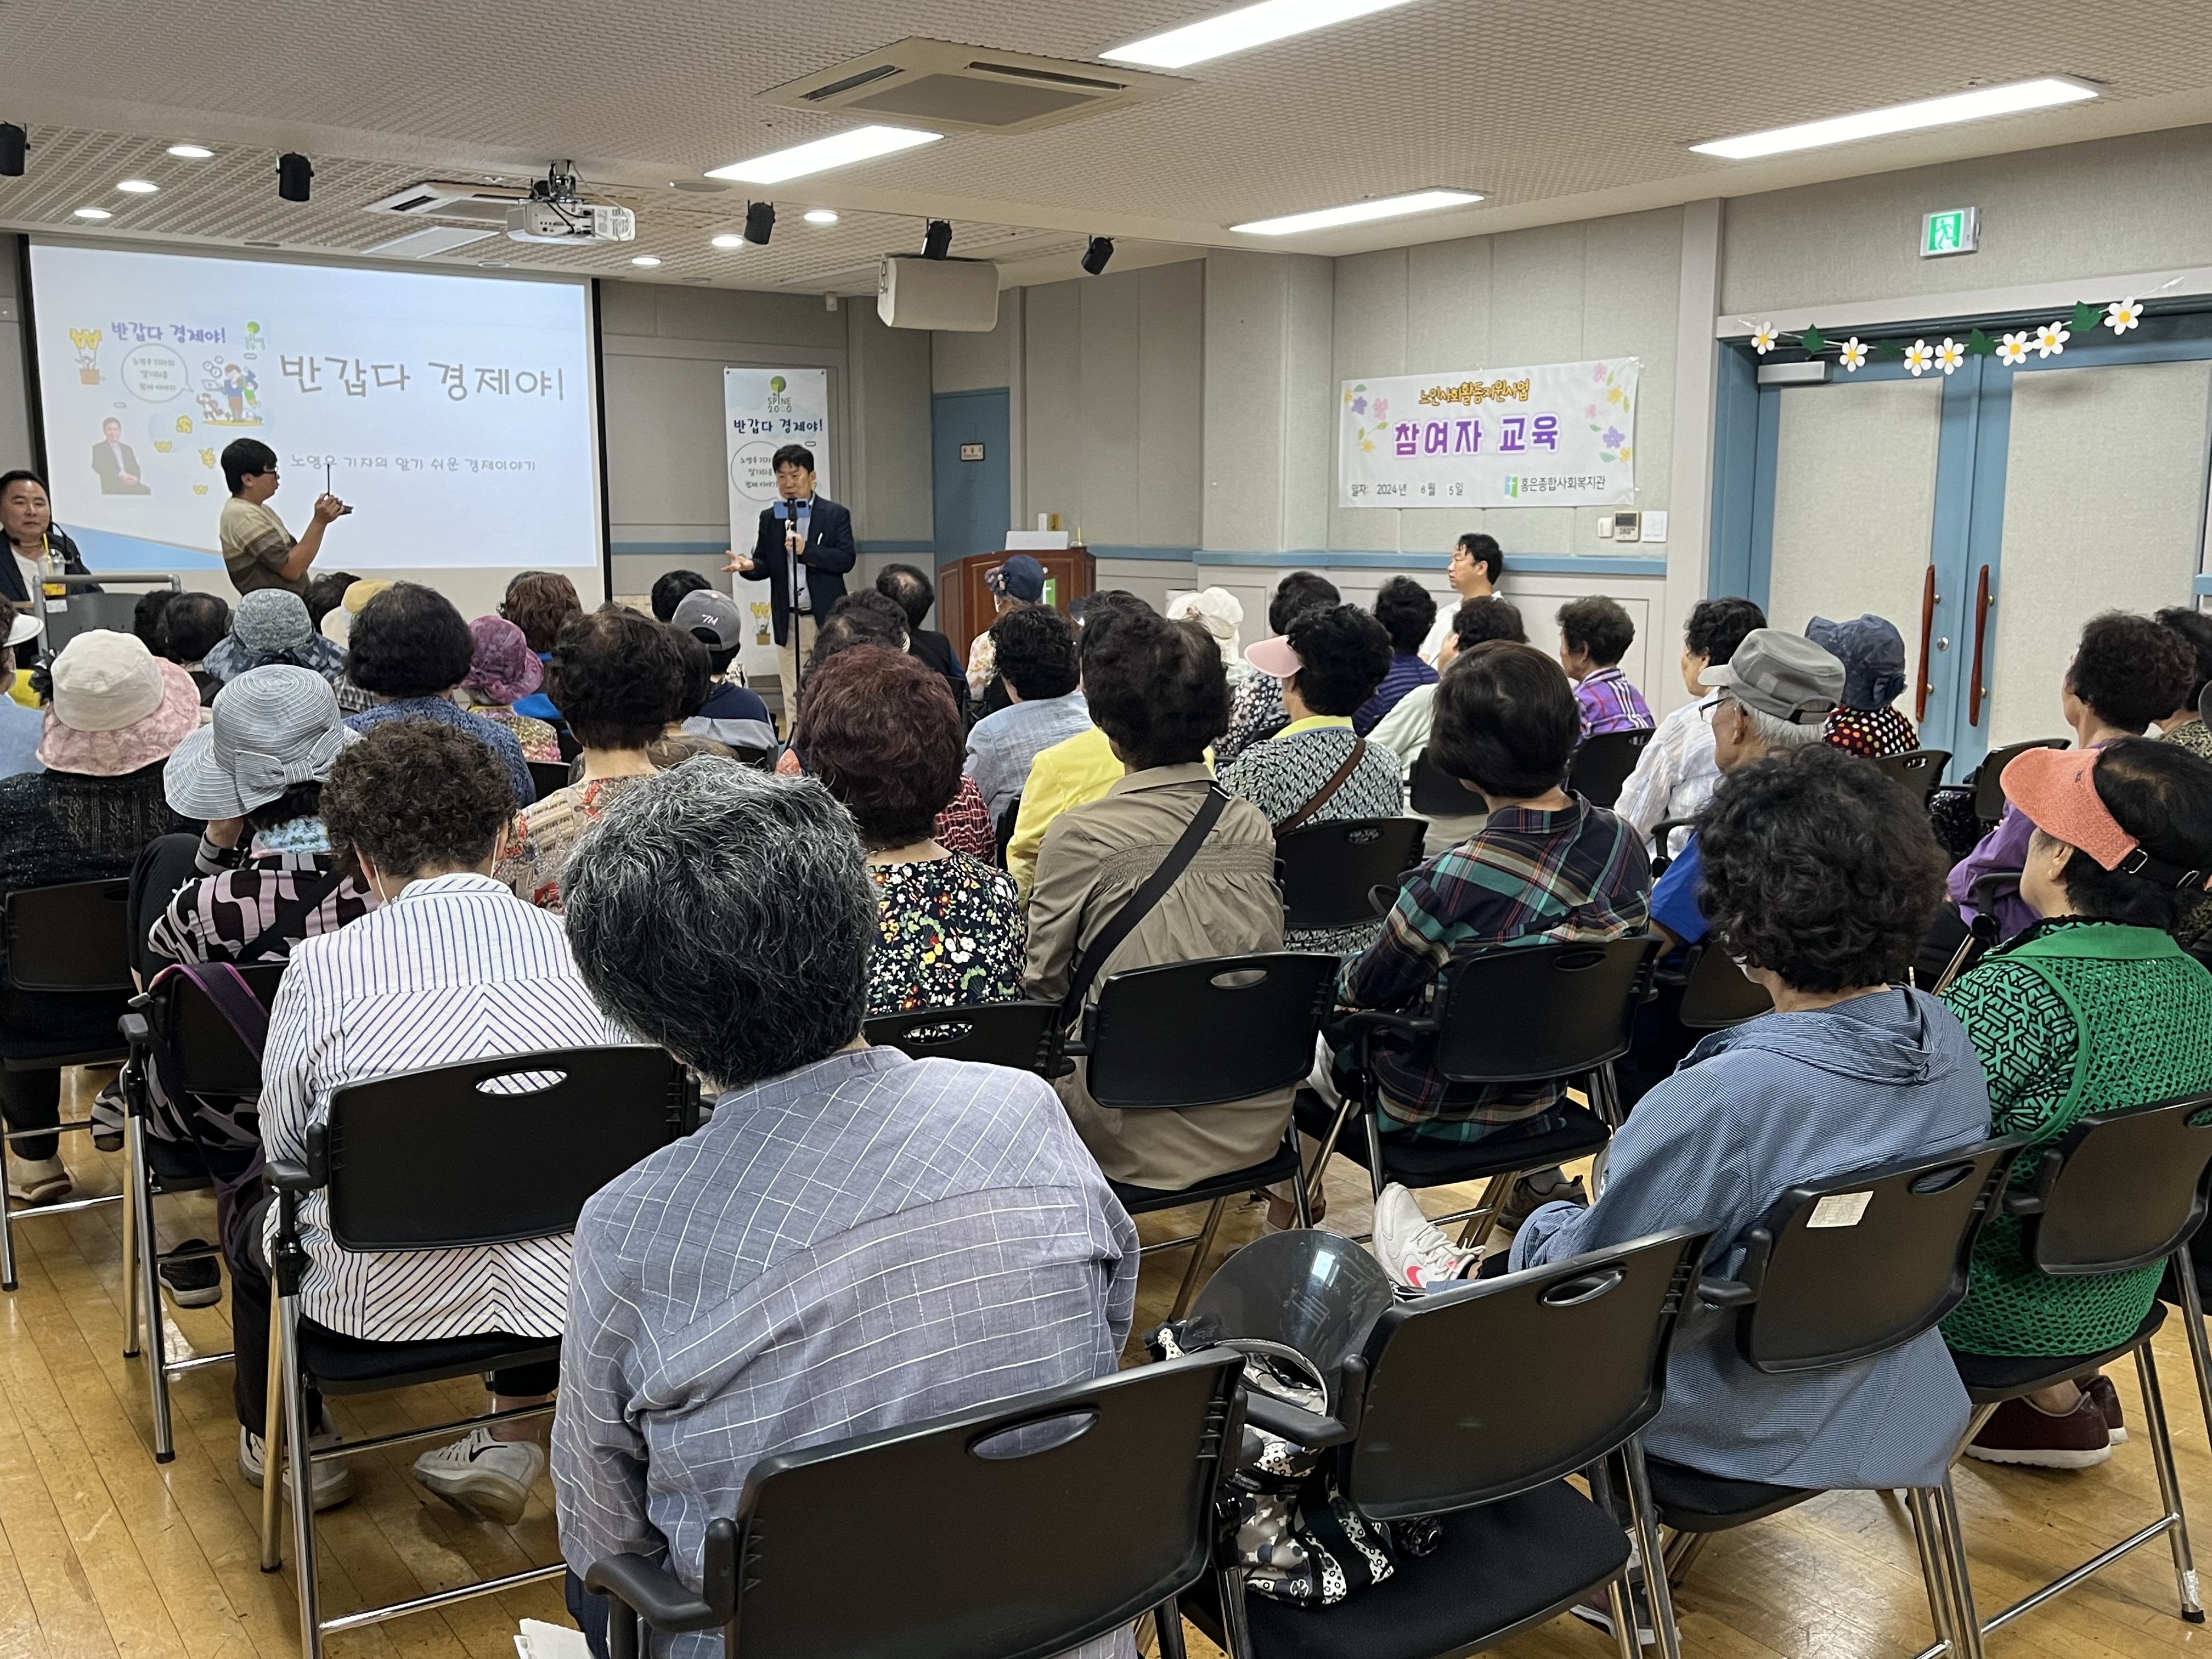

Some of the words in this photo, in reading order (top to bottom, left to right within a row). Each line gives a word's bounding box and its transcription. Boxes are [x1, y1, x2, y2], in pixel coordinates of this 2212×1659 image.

[111, 321, 163, 342] 반갑다
[170, 324, 226, 343] 경제야!
[280, 354, 410, 397] 반갑다
[428, 362, 563, 401] 경제야!
[768, 396, 791, 405] SPINE
[1418, 378, 1531, 407] 노인사회활동지원사업
[733, 419, 773, 434] 반갑다
[780, 419, 823, 433] 경제야!
[1395, 420, 1483, 456] 참여자
[1499, 415, 1559, 452] 교육
[291, 454, 337, 470] 노영우
[343, 456, 387, 469] 기자의
[395, 456, 423, 471] 알기
[431, 456, 460, 471] 쉬운
[465, 458, 536, 473] 경제이야기
[1351, 483, 1369, 496] 일자:
[1520, 475, 1606, 492] 홍은종합사회복지관
